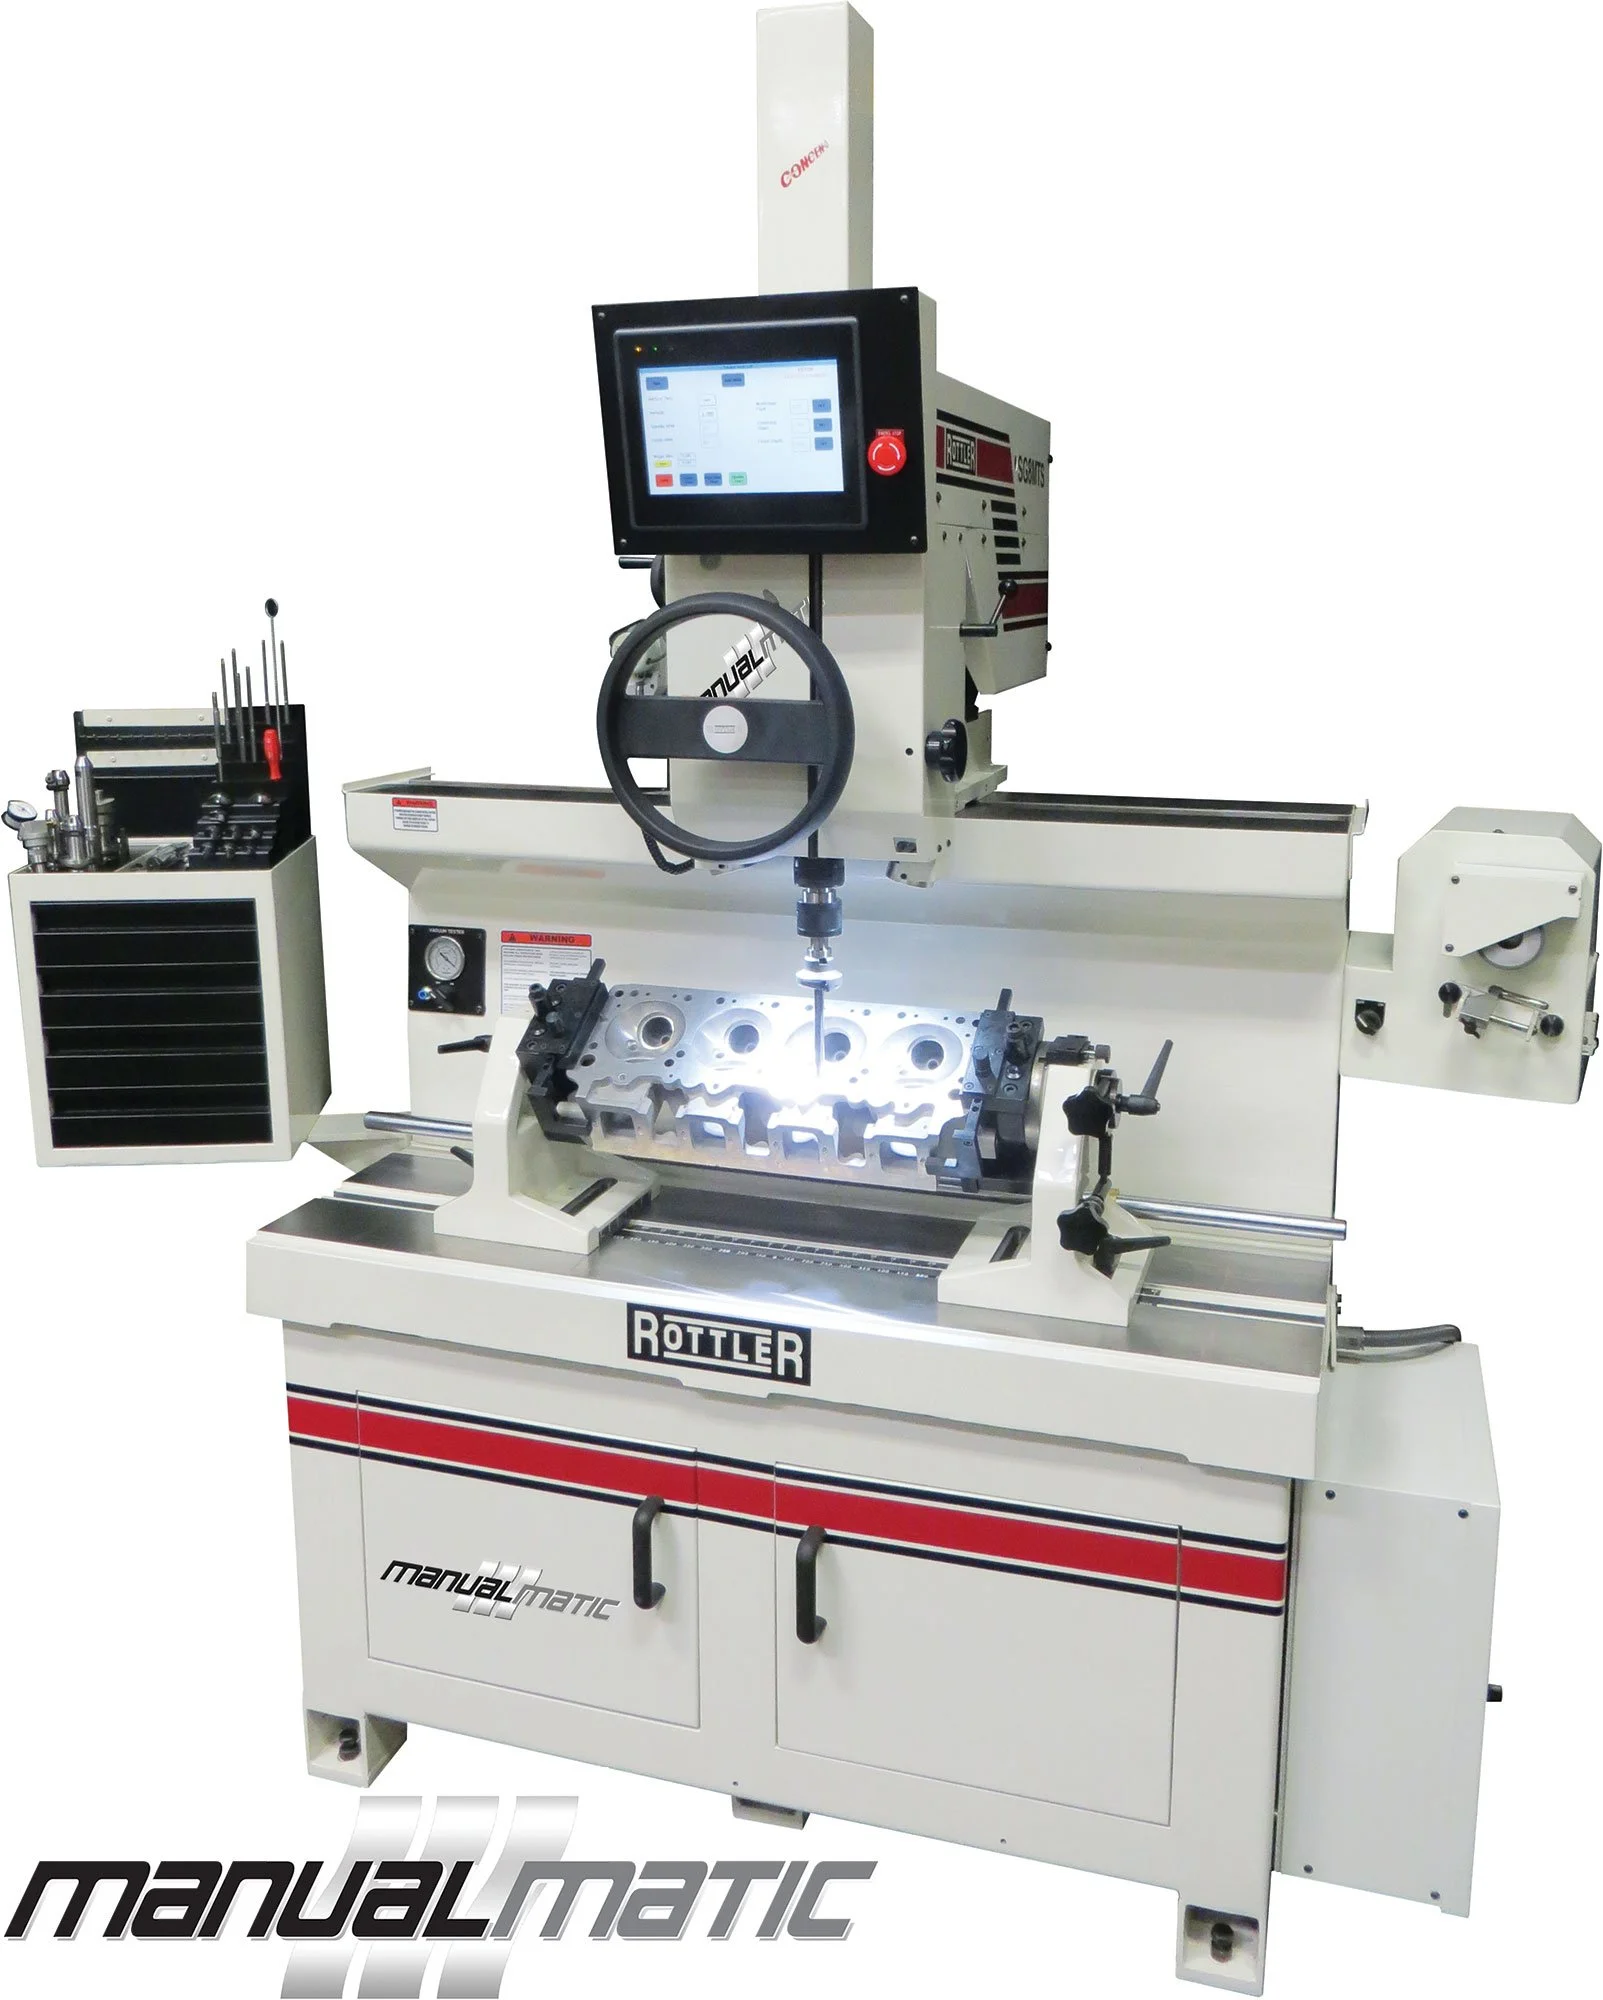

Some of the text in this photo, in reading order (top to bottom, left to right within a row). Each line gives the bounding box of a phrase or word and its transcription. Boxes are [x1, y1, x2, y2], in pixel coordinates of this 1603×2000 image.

[946, 433, 976, 473] ROTTLER
[529, 934, 576, 944] WARNING
[634, 1310, 804, 1379] ROTTLER
